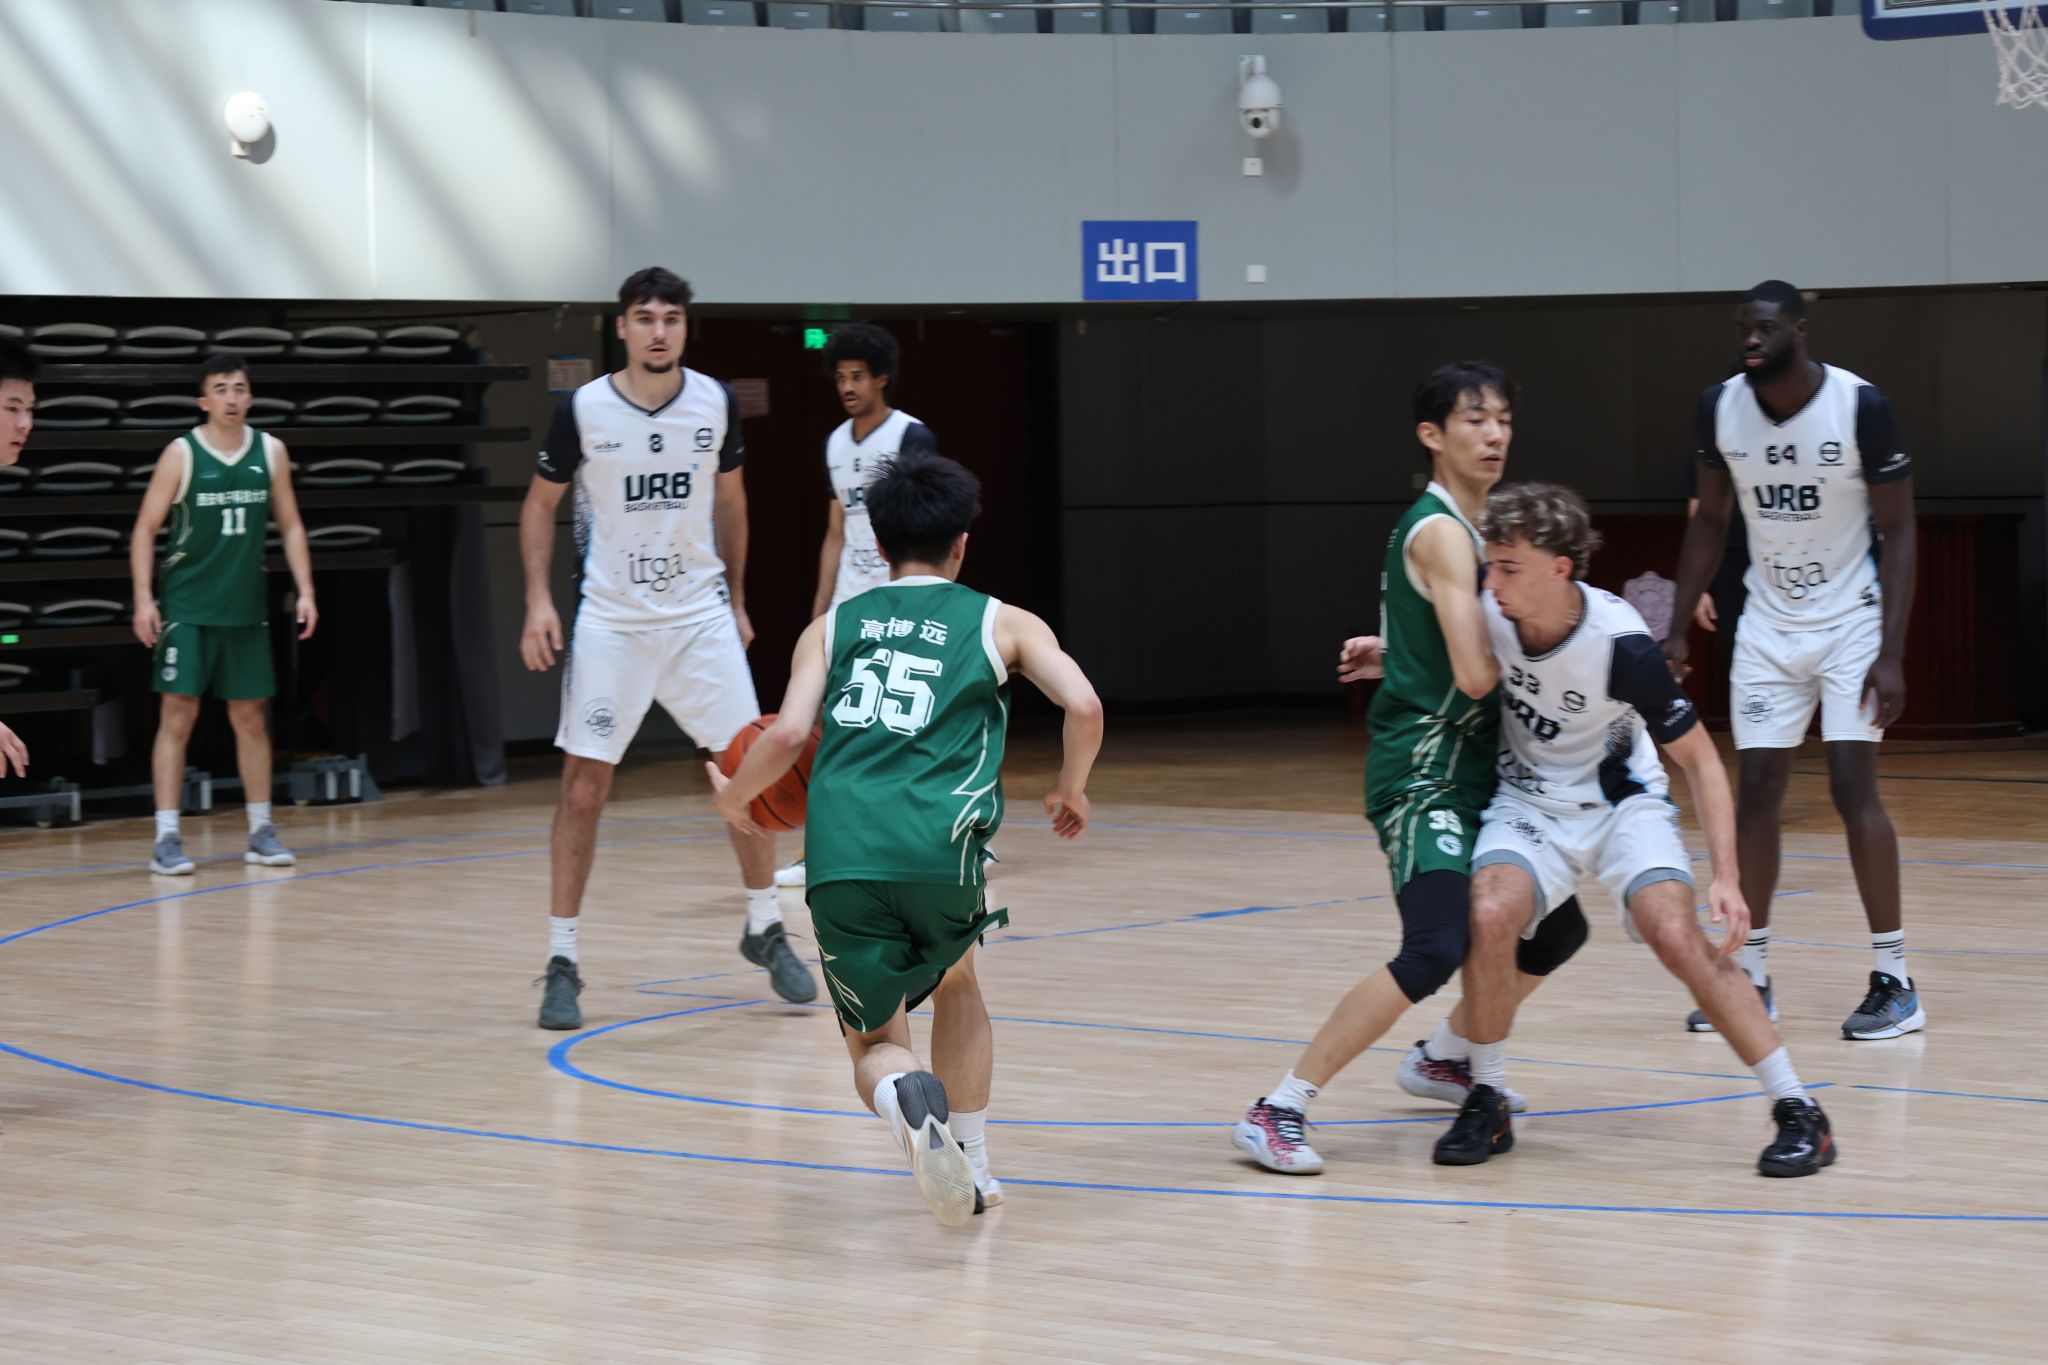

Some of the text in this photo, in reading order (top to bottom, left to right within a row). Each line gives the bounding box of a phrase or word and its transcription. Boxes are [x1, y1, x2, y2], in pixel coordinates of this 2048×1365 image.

[1097, 239, 1186, 284] 出口
[1766, 444, 1798, 465] 64
[624, 472, 691, 501] URB
[1754, 484, 1821, 511] URB
[221, 507, 247, 535] 11
[1763, 557, 1829, 599] itga
[860, 617, 948, 646] 高博远
[832, 648, 943, 736] 55
